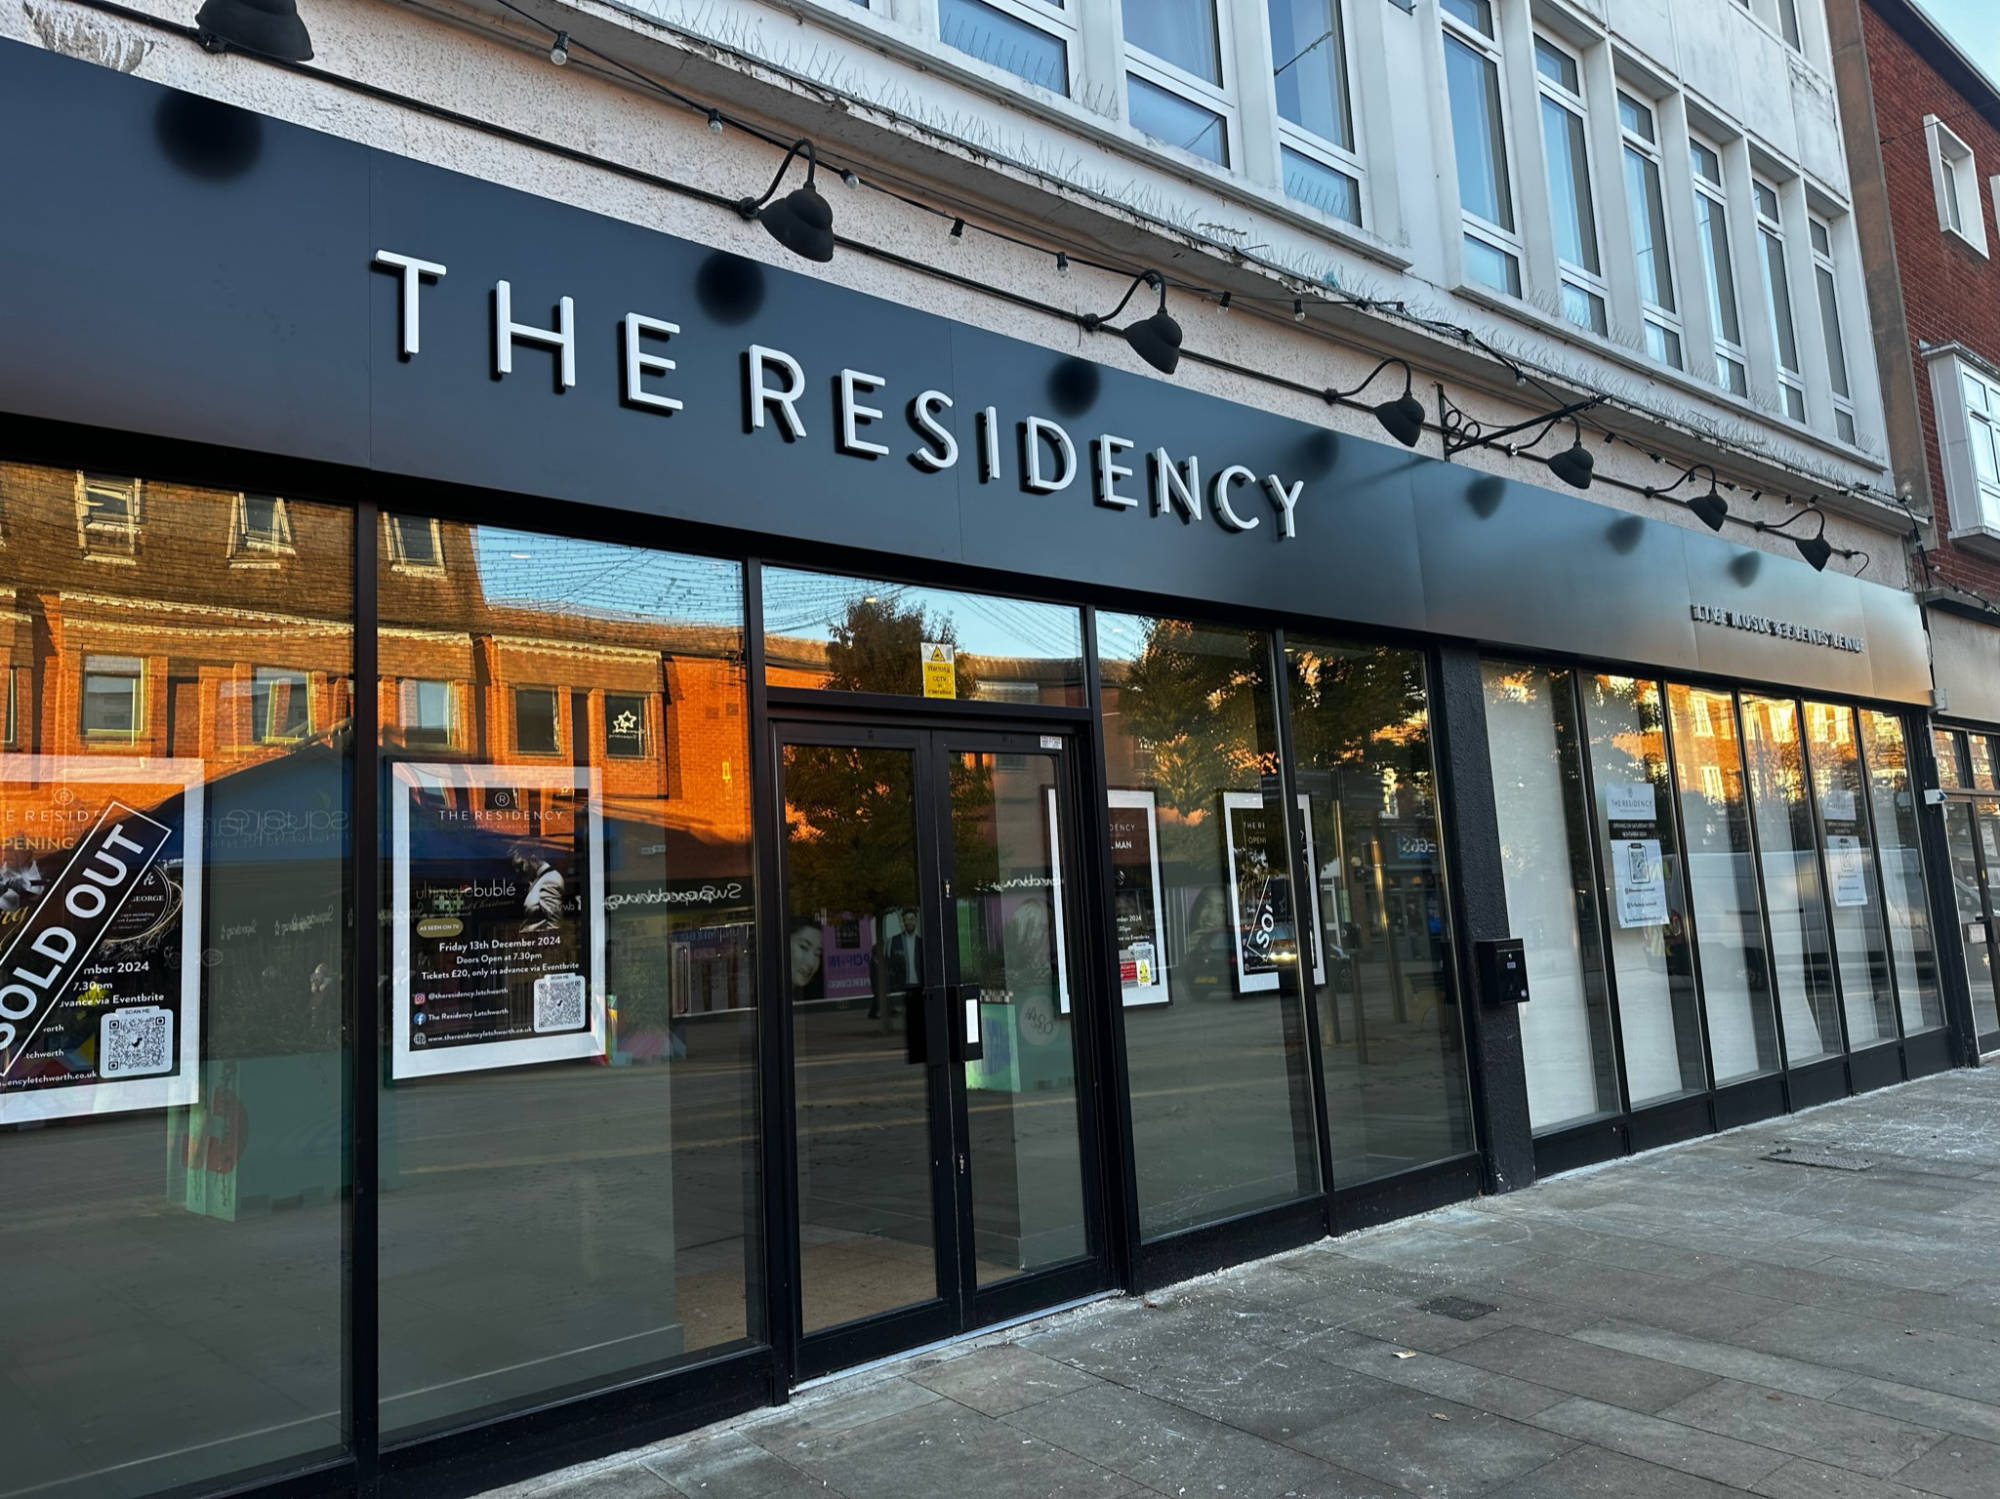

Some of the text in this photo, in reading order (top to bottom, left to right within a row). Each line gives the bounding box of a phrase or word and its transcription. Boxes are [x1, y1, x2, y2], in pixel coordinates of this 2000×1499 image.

[374, 248, 1304, 538] THE RESIDENCY
[1731, 610, 1772, 633] MUSIC
[438, 810, 563, 821] THE RESIDENCY
[64, 823, 144, 919] OUT
[439, 936, 561, 953] Friday 13th December 2024
[456, 955, 479, 965] Doors
[481, 954, 503, 964] Open
[512, 952, 543, 963] 7.30pm
[117, 961, 150, 973] 2024
[422, 961, 580, 981] Tickets £20, only in advance via Eventbrite
[96, 996, 110, 1005] via
[112, 993, 165, 1005] Eventbrite
[441, 1011, 473, 1020] Residency
[474, 1008, 509, 1017] Letchworth
